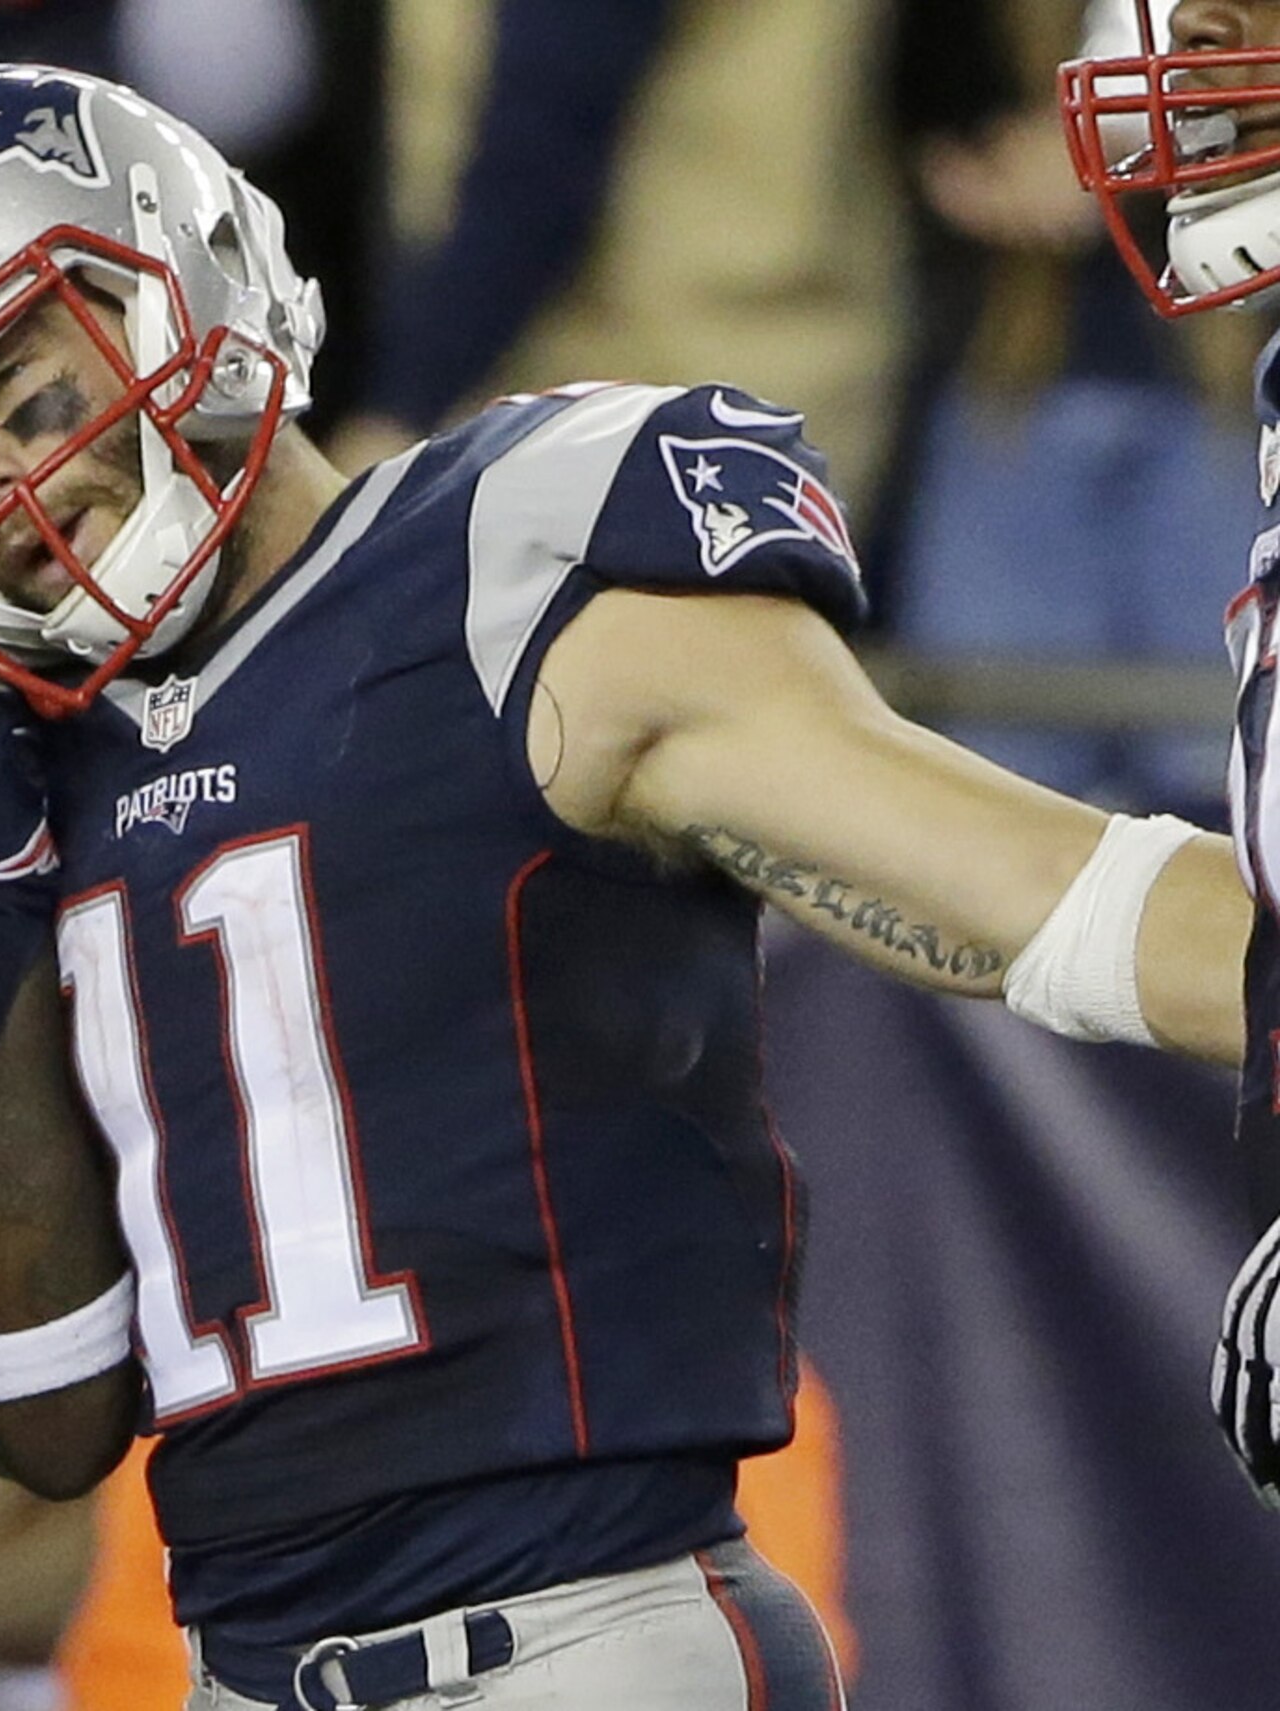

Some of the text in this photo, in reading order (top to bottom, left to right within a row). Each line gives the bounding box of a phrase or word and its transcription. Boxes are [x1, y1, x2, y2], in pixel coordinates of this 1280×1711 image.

[148, 704, 183, 738] NFL
[116, 763, 237, 838] PATRIOTS
[56, 822, 433, 1427] 11
